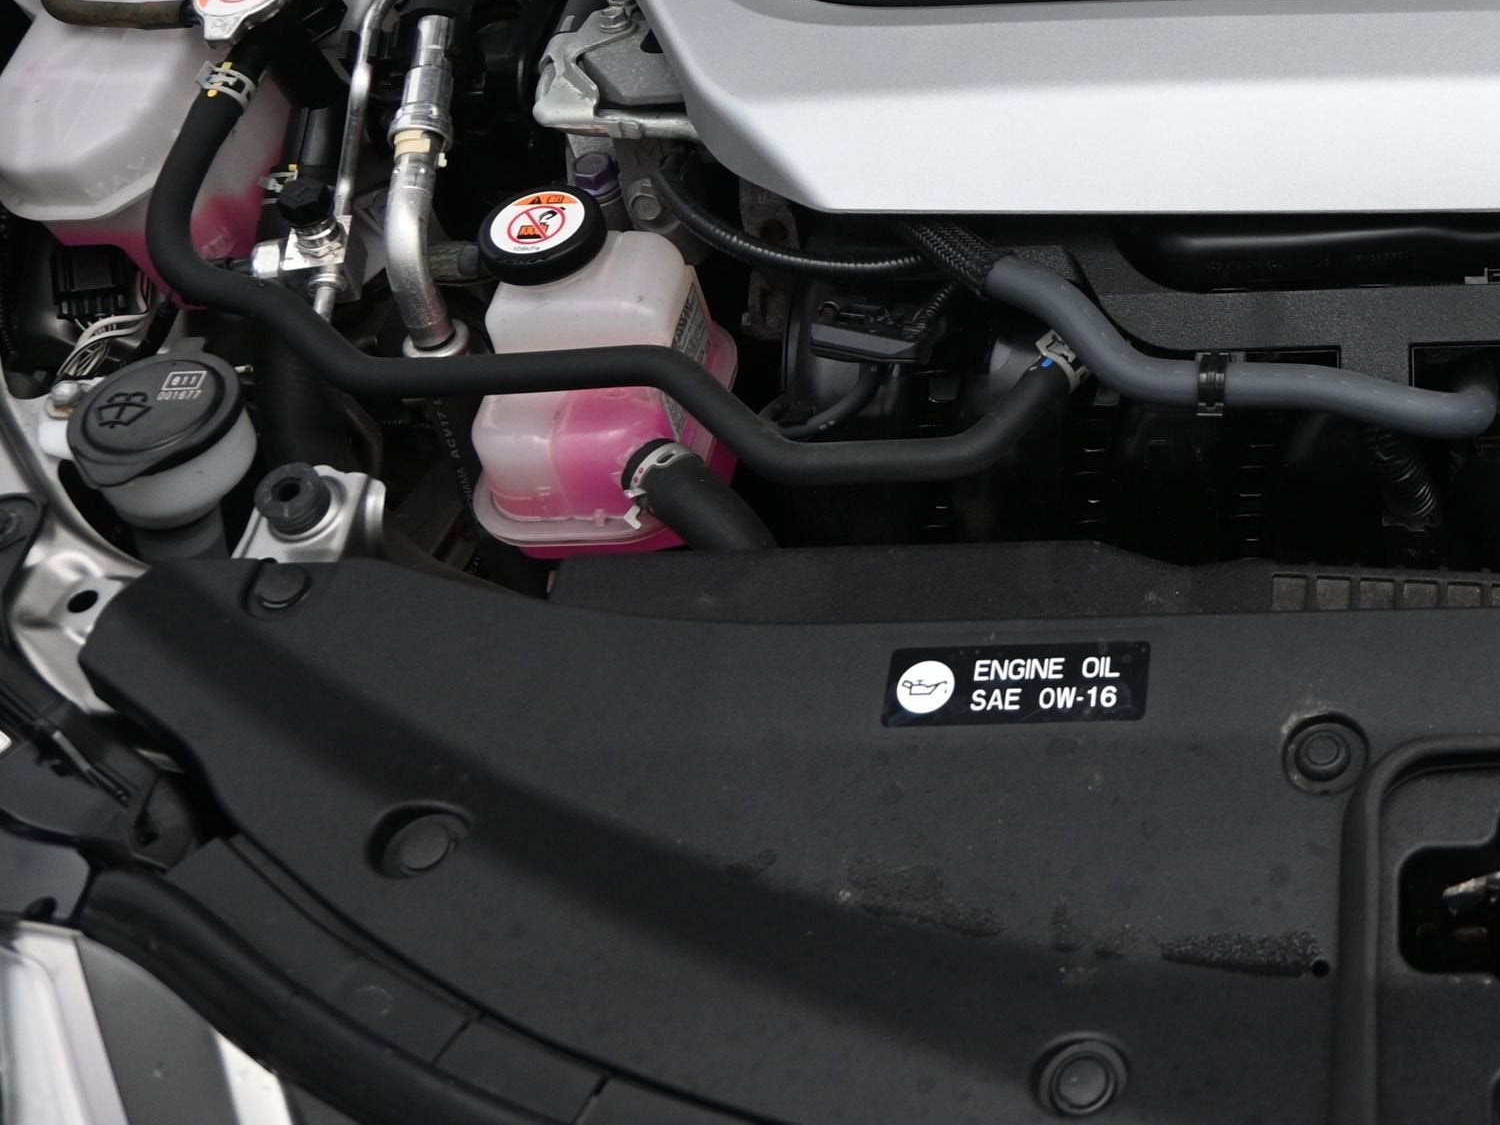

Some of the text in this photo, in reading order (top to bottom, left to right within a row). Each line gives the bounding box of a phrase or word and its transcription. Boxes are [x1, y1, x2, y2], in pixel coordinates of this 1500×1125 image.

[973, 656, 1120, 681] ENGINE OIL
[969, 686, 1118, 712] SAE 0W-16
